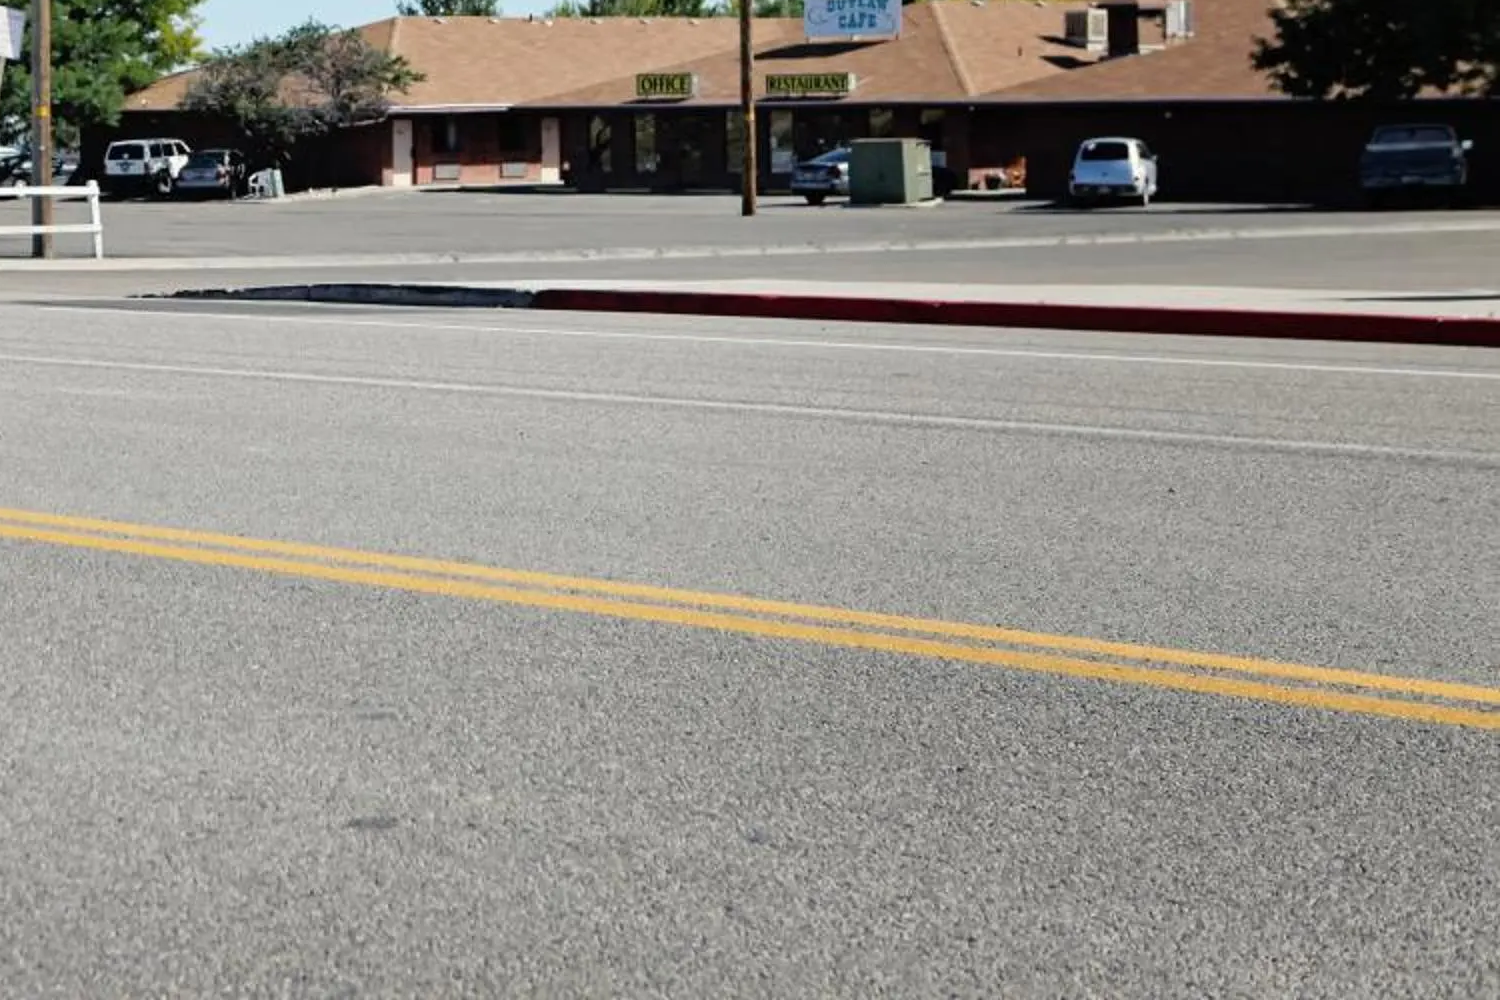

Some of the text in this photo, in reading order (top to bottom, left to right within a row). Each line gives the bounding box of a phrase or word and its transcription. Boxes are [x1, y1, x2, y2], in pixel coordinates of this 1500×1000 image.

[838, 13, 877, 29] CAFE
[641, 76, 690, 93] OFFICE
[769, 75, 846, 91] RESTAURANT
